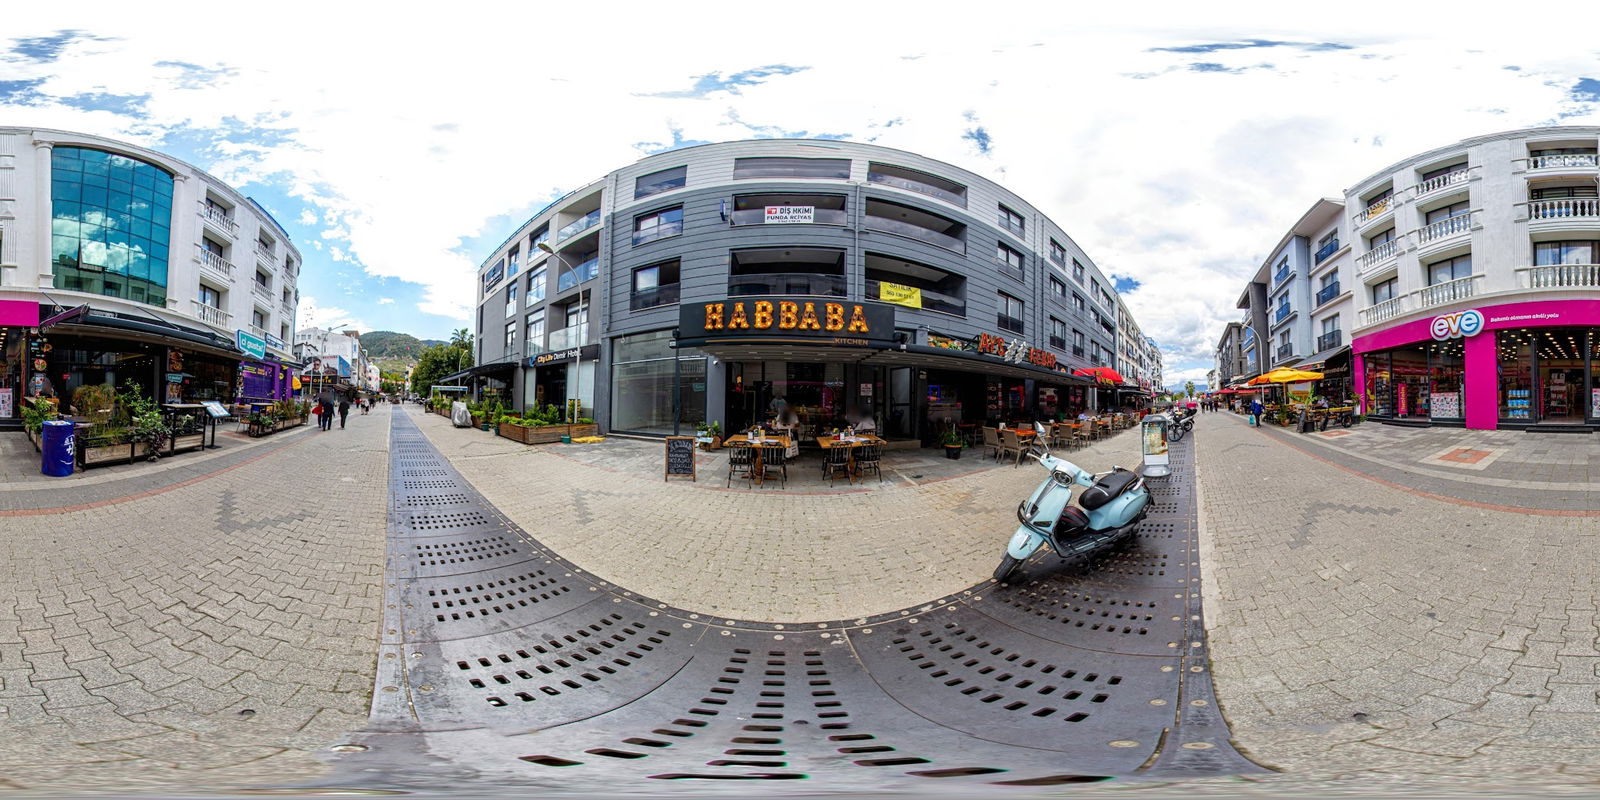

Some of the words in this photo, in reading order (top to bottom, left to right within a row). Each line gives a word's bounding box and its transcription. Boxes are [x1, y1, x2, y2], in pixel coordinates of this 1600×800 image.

[704, 301, 869, 332] HABBABA
[1431, 310, 1482, 339] eve
[834, 338, 869, 346] KITCHEN
